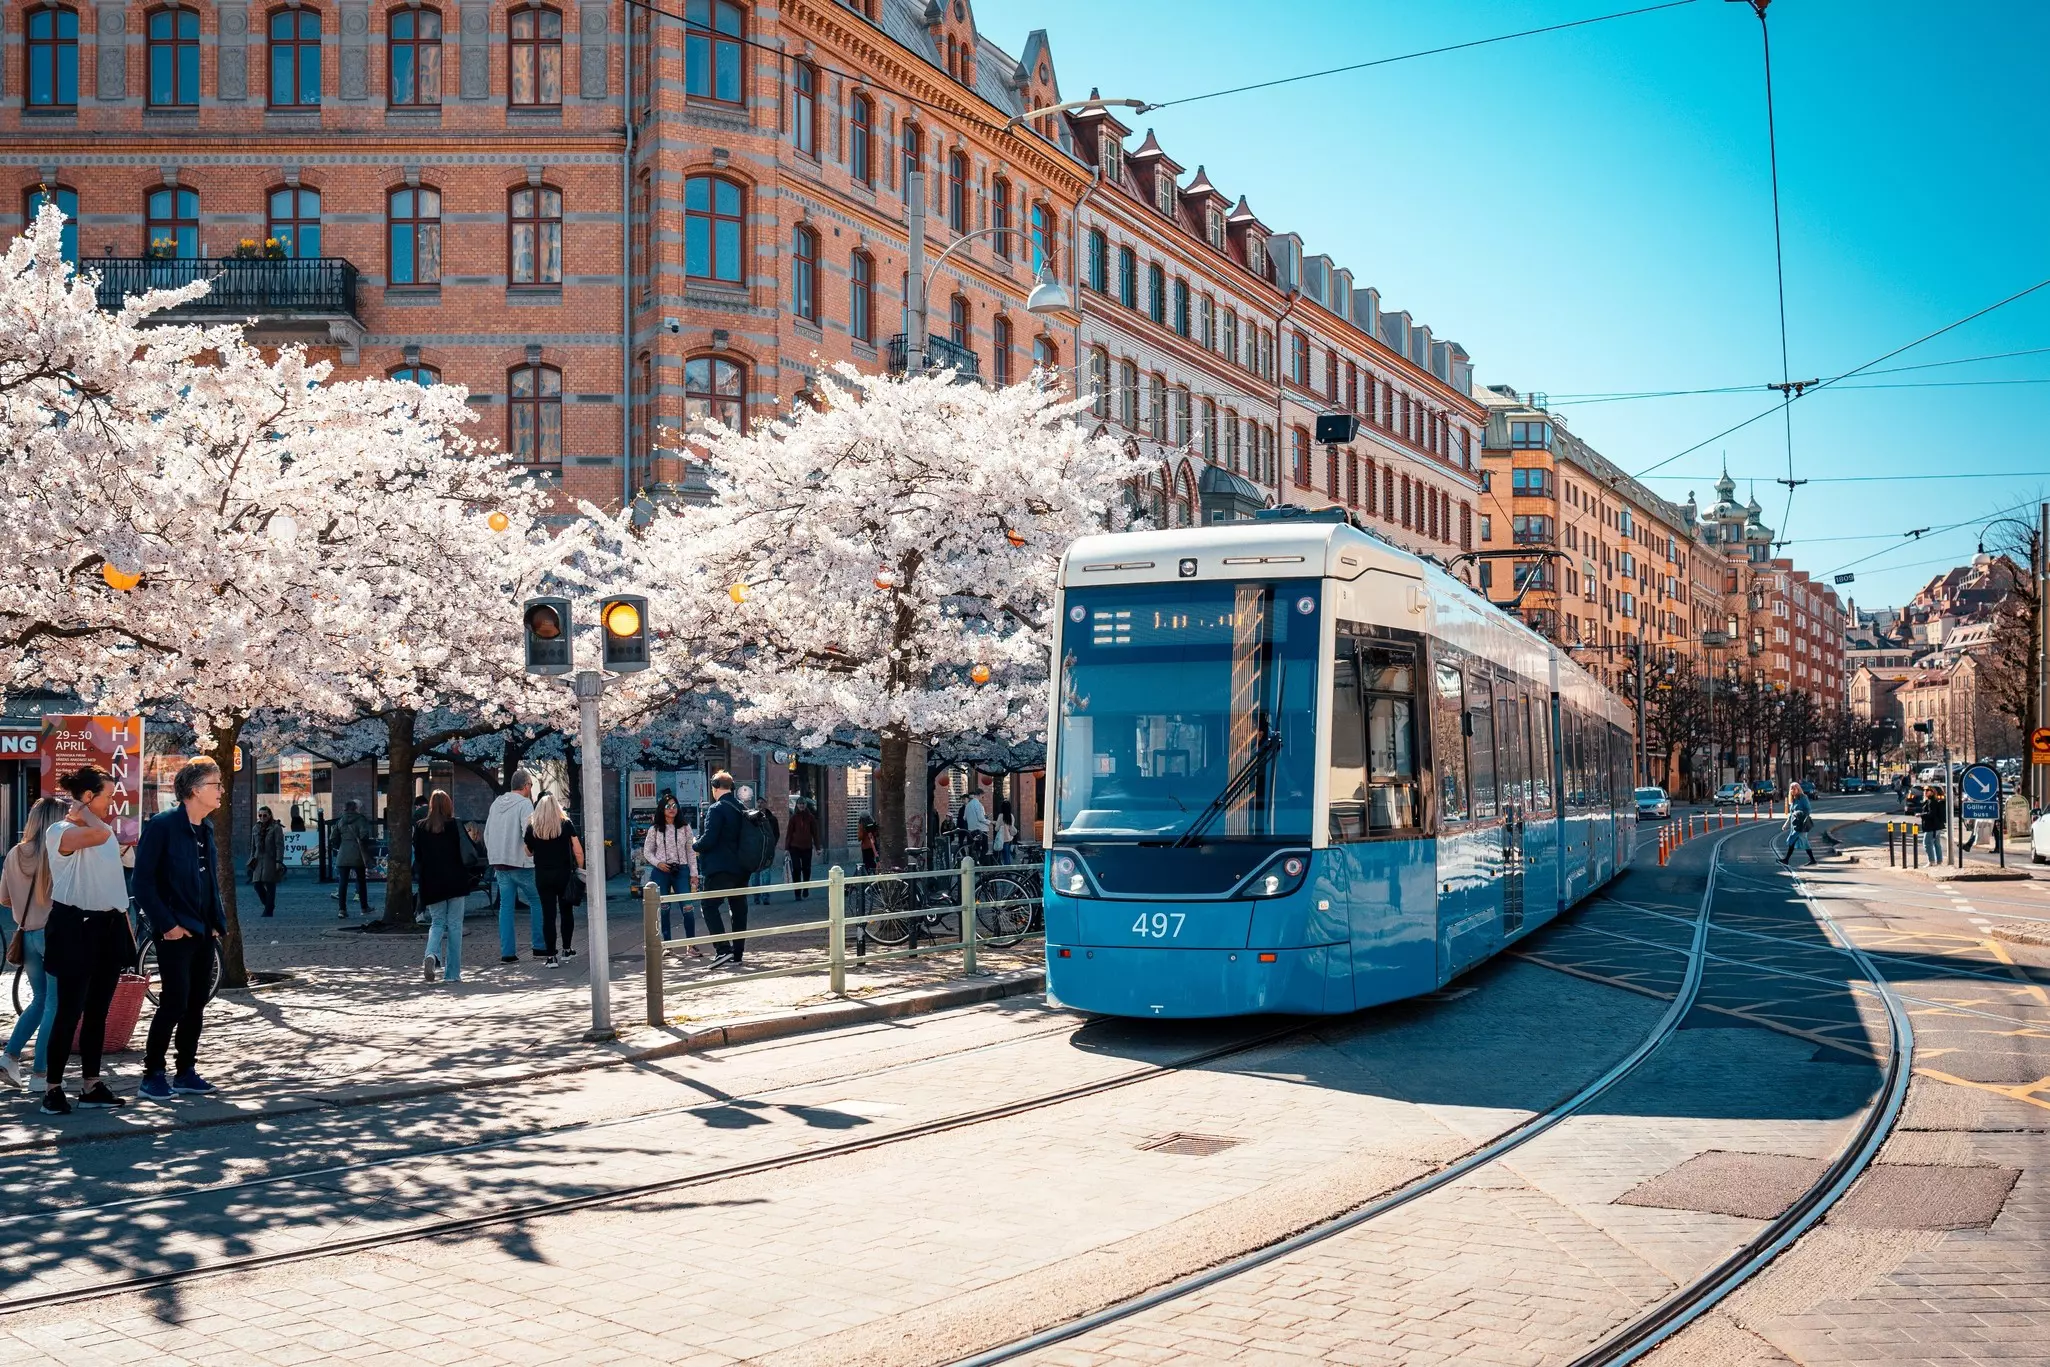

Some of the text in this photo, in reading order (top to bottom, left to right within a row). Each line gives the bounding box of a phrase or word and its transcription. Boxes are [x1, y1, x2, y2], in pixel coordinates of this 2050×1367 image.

[55, 741, 87, 751] APRIL
[109, 727, 130, 834] HANAMI
[290, 845, 308, 853] you
[1132, 912, 1186, 938] 497
